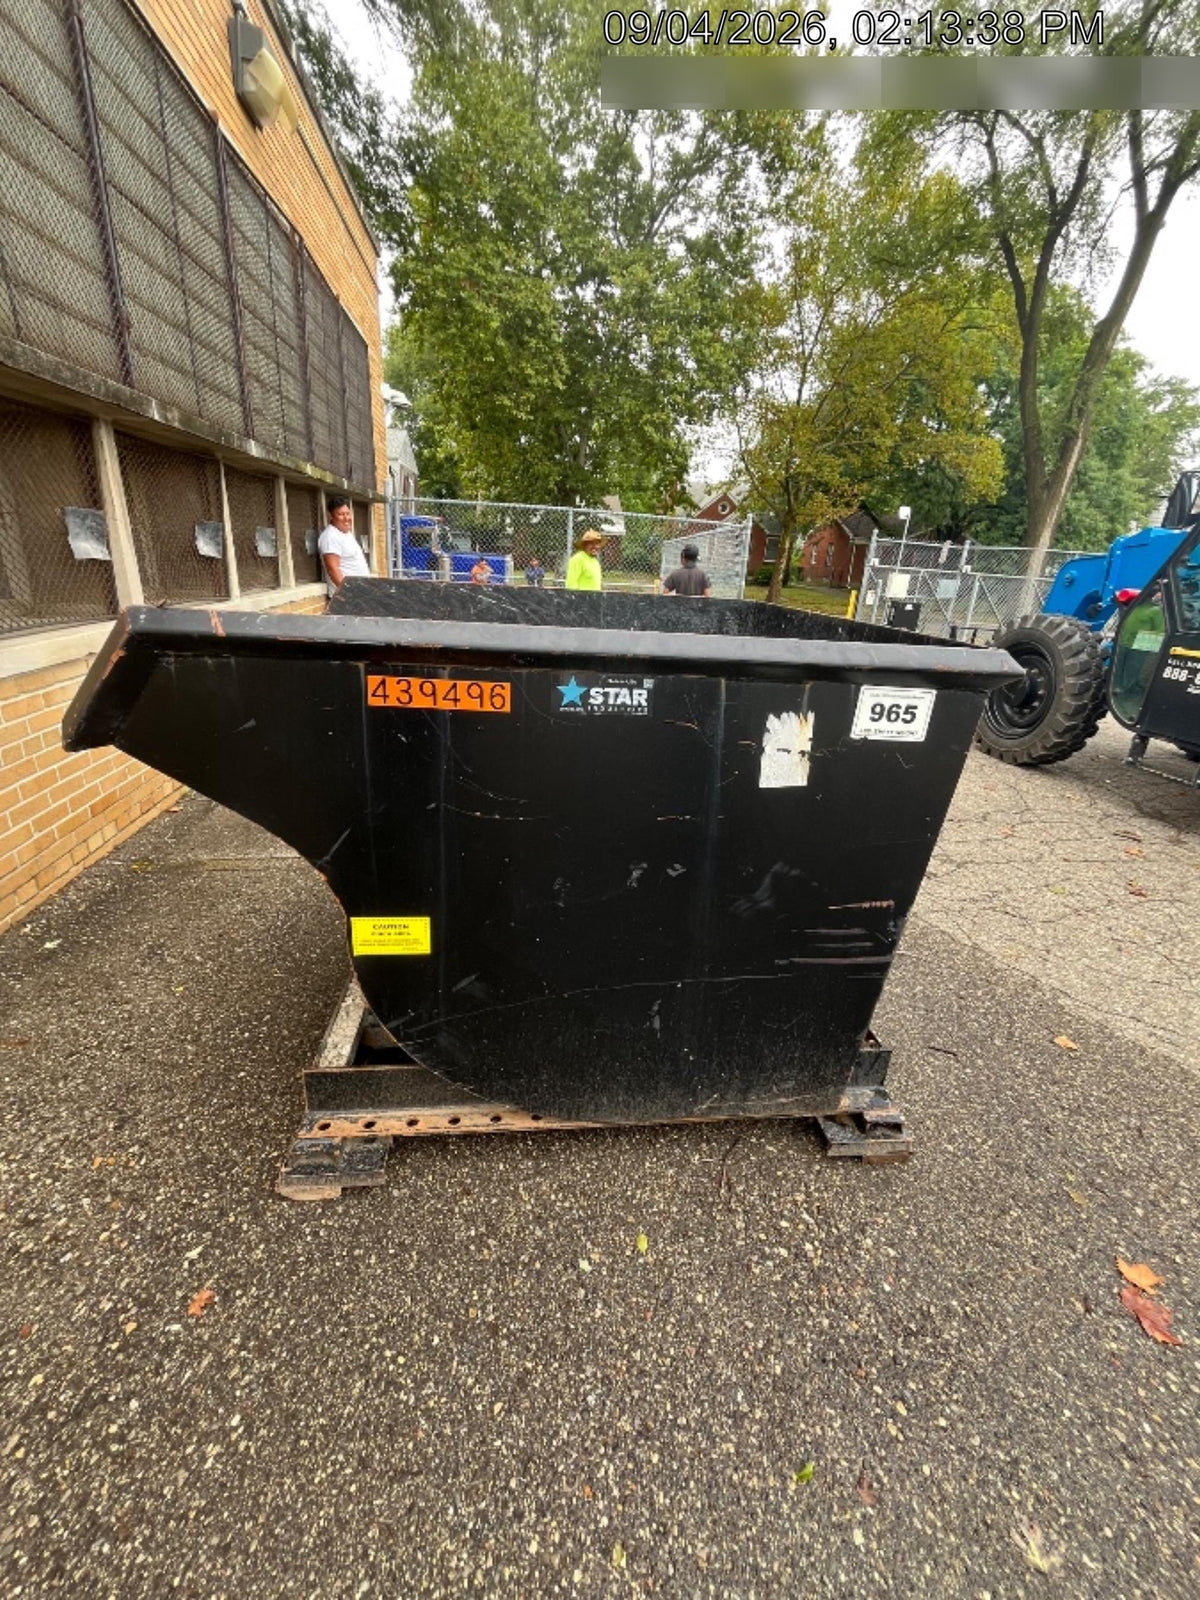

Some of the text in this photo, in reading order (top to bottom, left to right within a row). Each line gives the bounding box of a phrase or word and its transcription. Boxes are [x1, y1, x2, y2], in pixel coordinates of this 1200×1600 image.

[371, 677, 506, 710] 439496
[588, 687, 648, 706] STAR
[869, 702, 918, 724] 965
